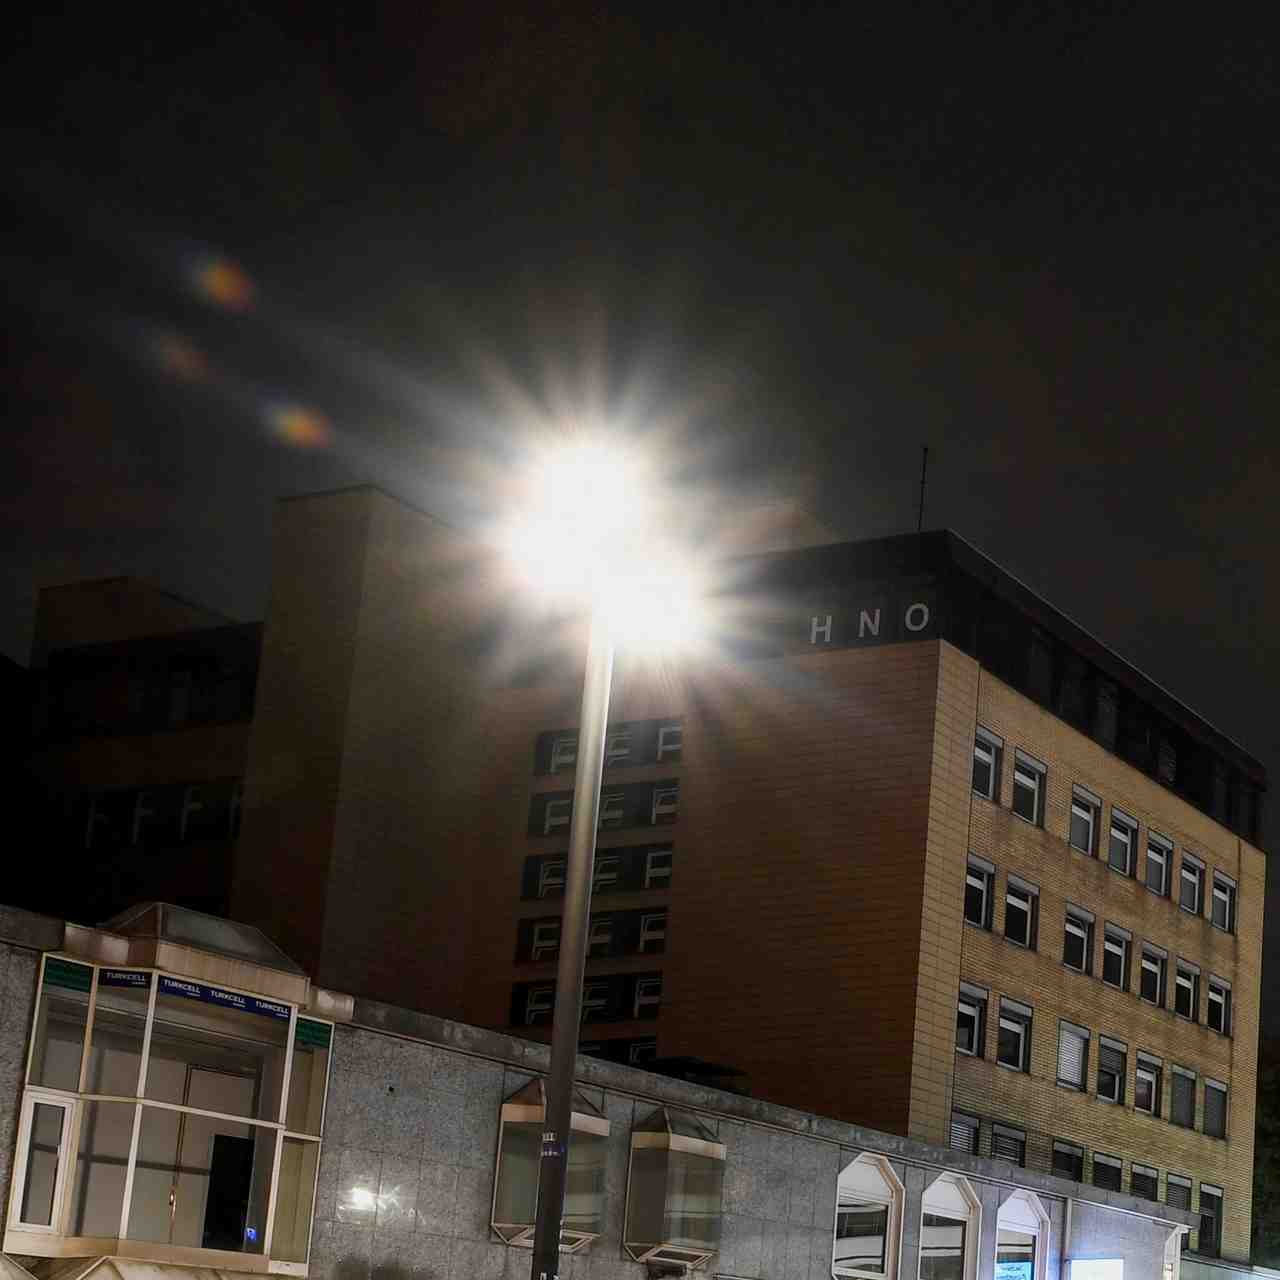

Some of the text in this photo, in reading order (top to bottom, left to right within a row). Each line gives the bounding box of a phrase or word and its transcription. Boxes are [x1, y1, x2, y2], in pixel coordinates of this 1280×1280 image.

[106, 972, 147, 982] TURKCELL
[164, 979, 200, 993] TURKCELL
[211, 990, 245, 1003] TURKCELL
[255, 1001, 288, 1013] TURKCELL
